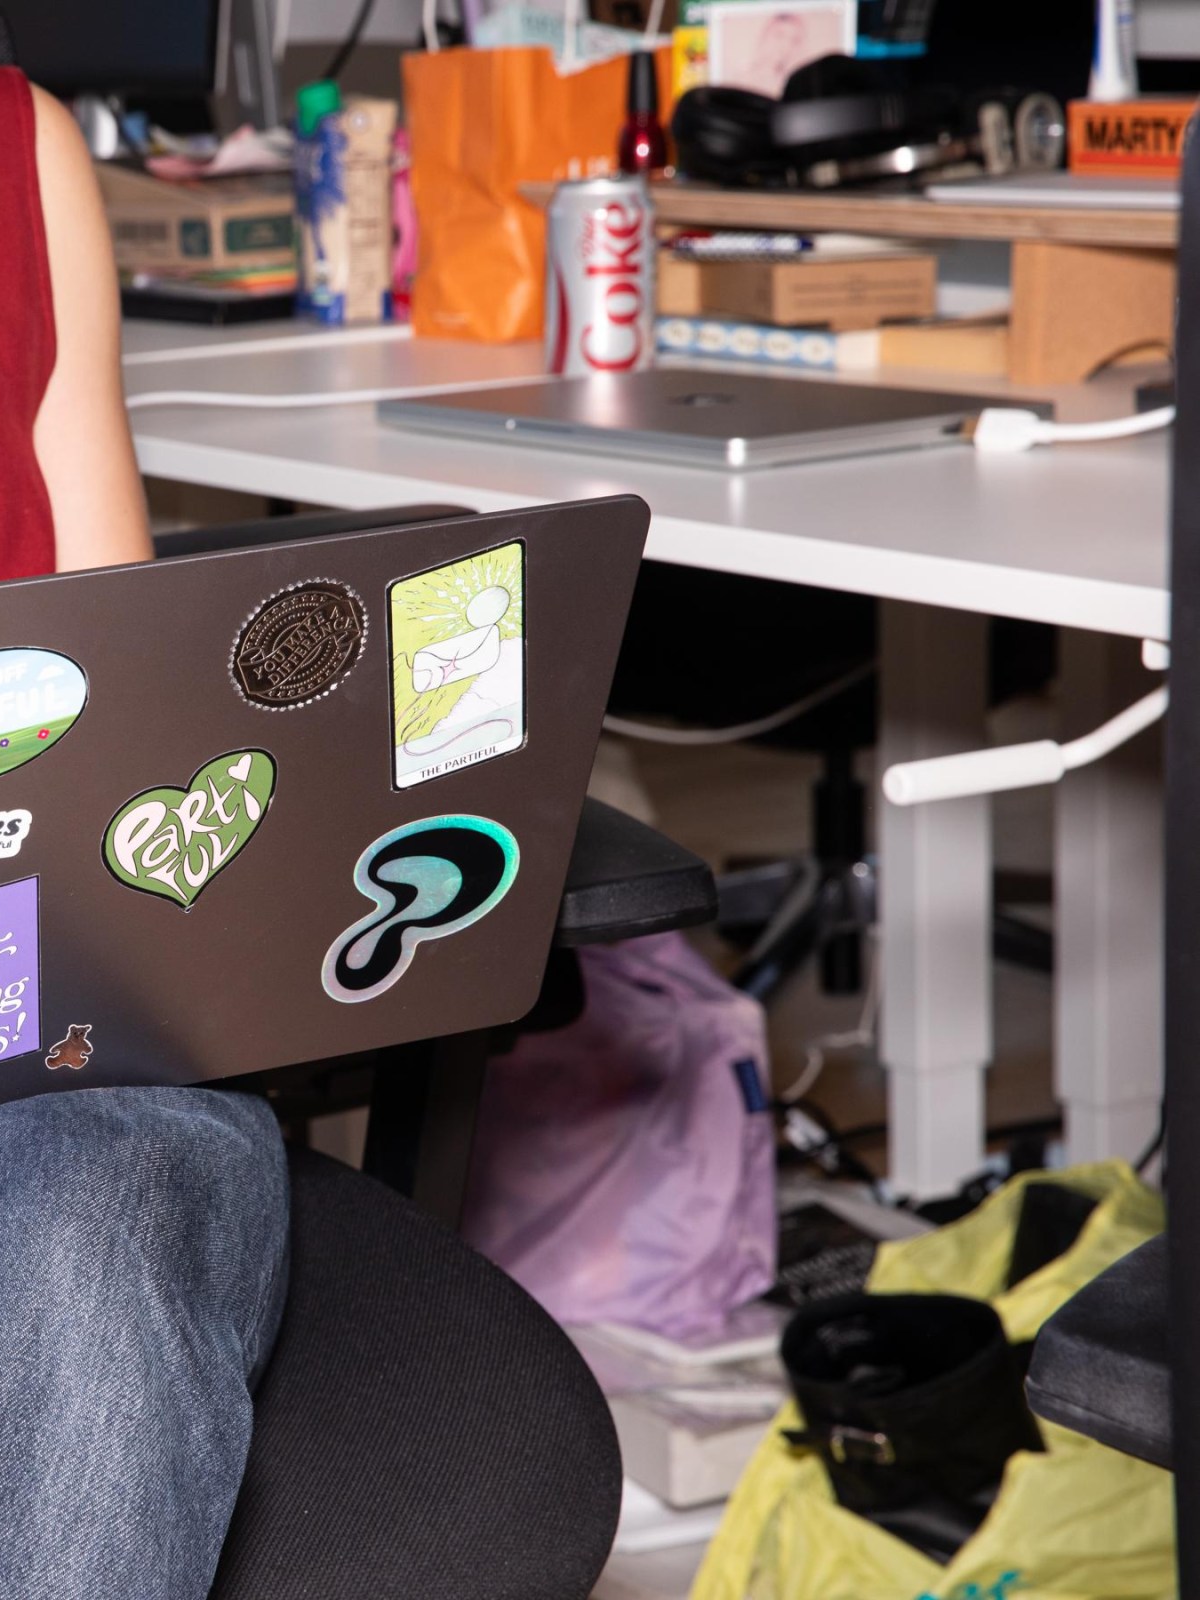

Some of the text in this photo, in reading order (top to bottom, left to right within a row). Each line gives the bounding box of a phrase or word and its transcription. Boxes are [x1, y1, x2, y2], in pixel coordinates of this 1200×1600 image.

[1085, 115, 1182, 153] MARTY
[579, 203, 644, 373] Coke
[253, 652, 286, 679] YOU
[285, 612, 326, 651] MAKE
[268, 617, 353, 686] DIFFERENCE
[420, 746, 499, 779] THE PARTIFUL
